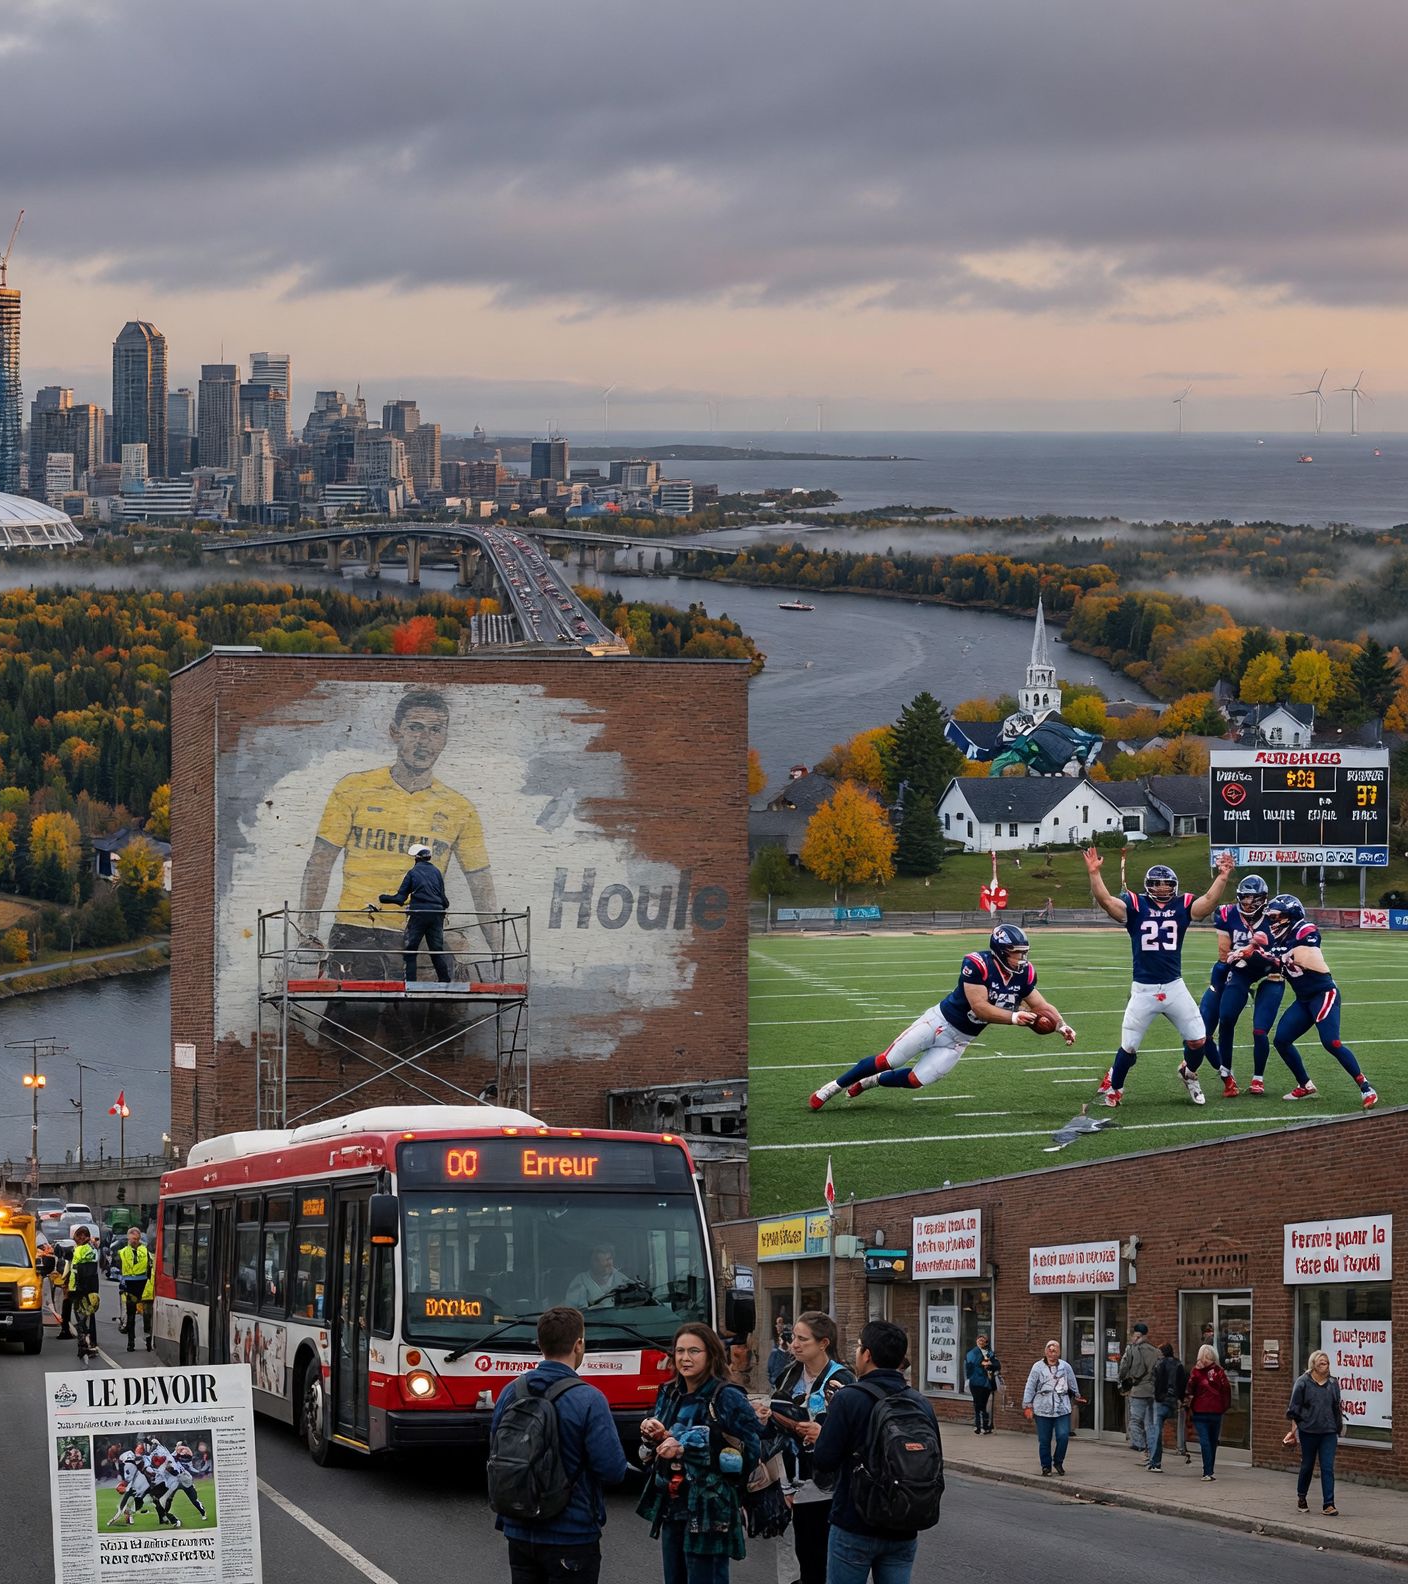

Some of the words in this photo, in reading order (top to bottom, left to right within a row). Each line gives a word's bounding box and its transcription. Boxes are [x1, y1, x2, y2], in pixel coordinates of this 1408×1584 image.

[548, 866, 729, 931] Houle
[1140, 920, 1178, 951] 23
[523, 1150, 599, 1176] Erreur
[1373, 1224, 1385, 1244] la
[1324, 1256, 1339, 1273] du
[87, 1378, 118, 1407] LE
[123, 1374, 218, 1406] DEVOIR
